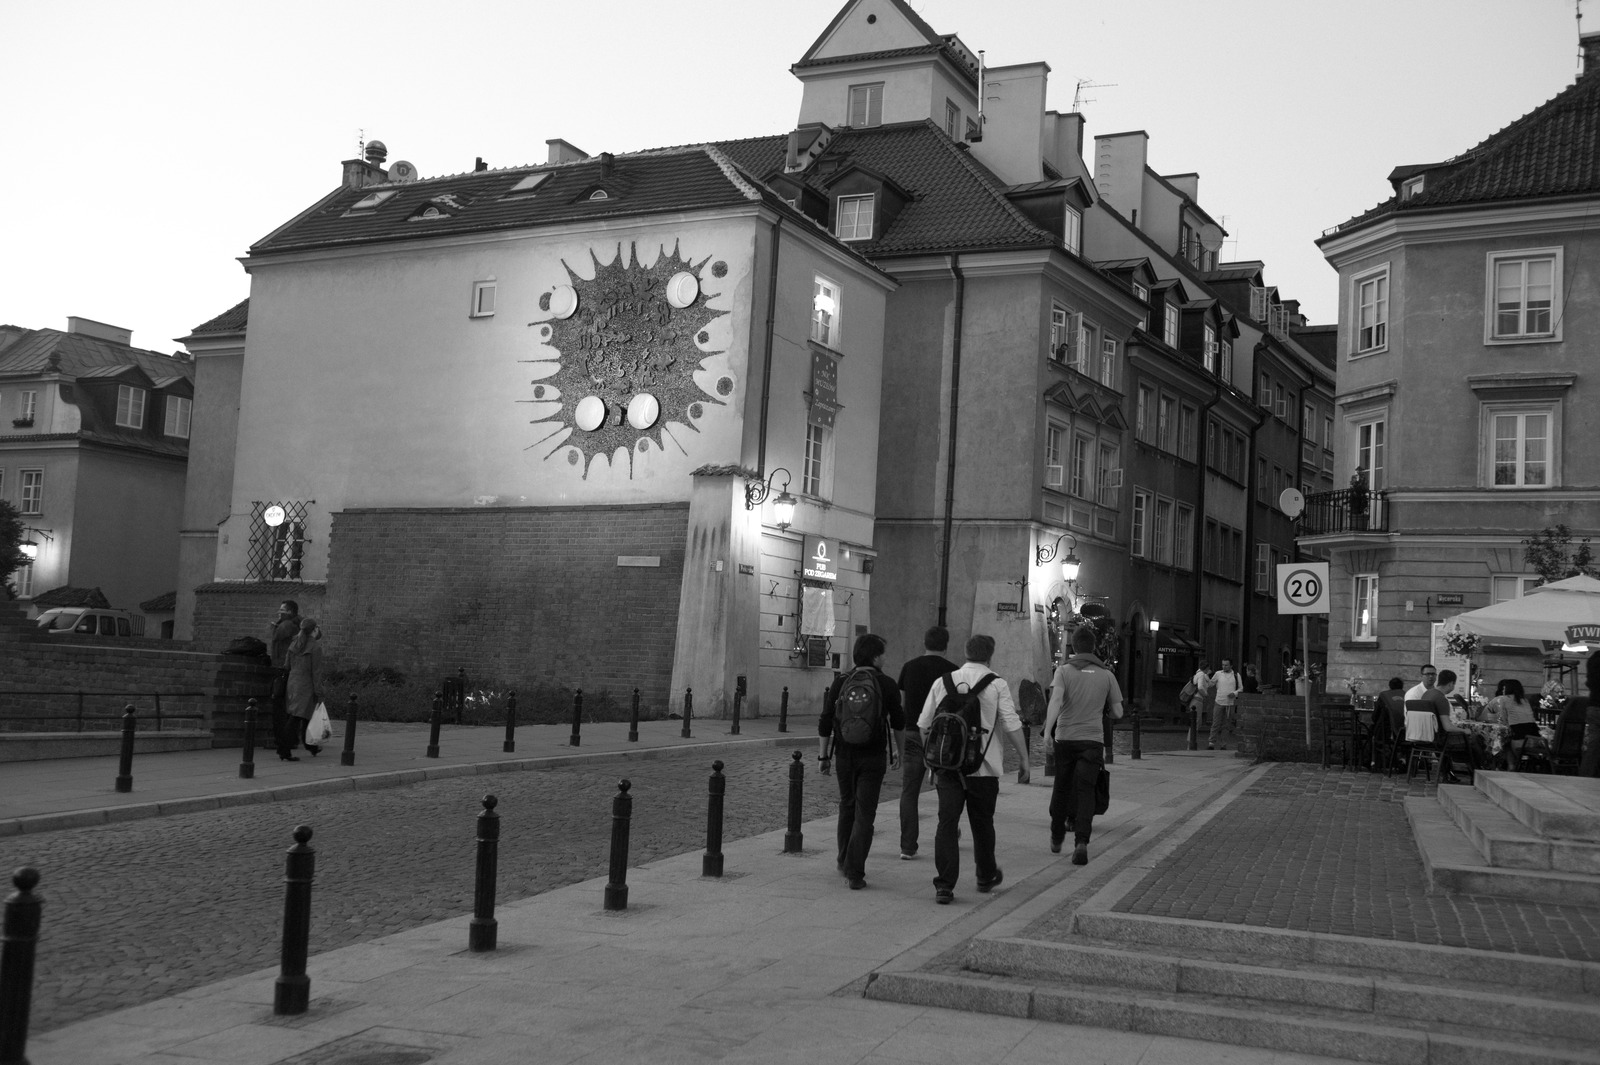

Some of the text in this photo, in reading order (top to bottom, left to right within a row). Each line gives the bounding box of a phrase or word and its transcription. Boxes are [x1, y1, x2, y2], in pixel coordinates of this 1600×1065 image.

[816, 562, 827, 571] PUB
[804, 568, 815, 577] POD
[1291, 579, 1318, 598] 20
